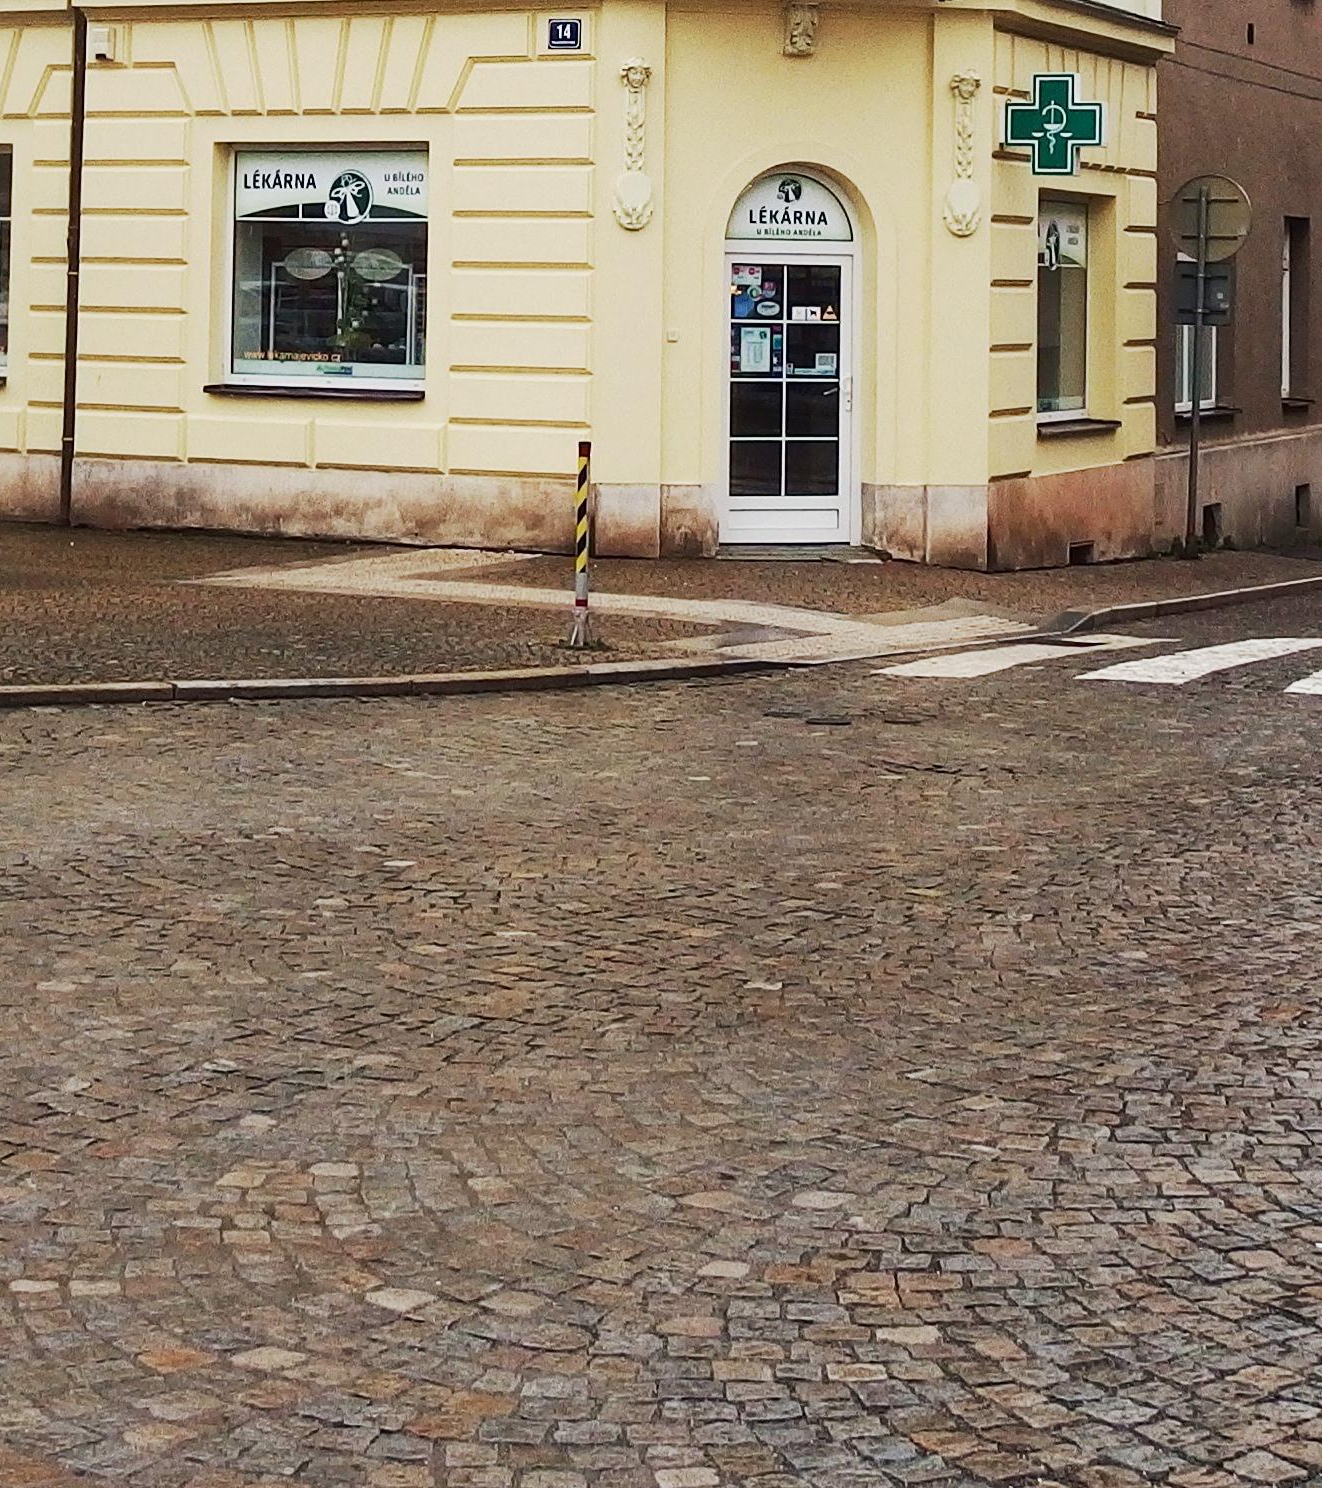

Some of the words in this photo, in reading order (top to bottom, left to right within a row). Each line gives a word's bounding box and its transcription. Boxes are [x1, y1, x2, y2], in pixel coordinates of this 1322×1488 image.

[557, 23, 571, 39] 14
[244, 170, 317, 189] LÉKÁRNA
[384, 174, 390, 182] U
[394, 171, 424, 182] BÍLÉHO
[749, 206, 828, 225] LÉKÁRNA
[764, 227, 791, 236] BÍLÉHO
